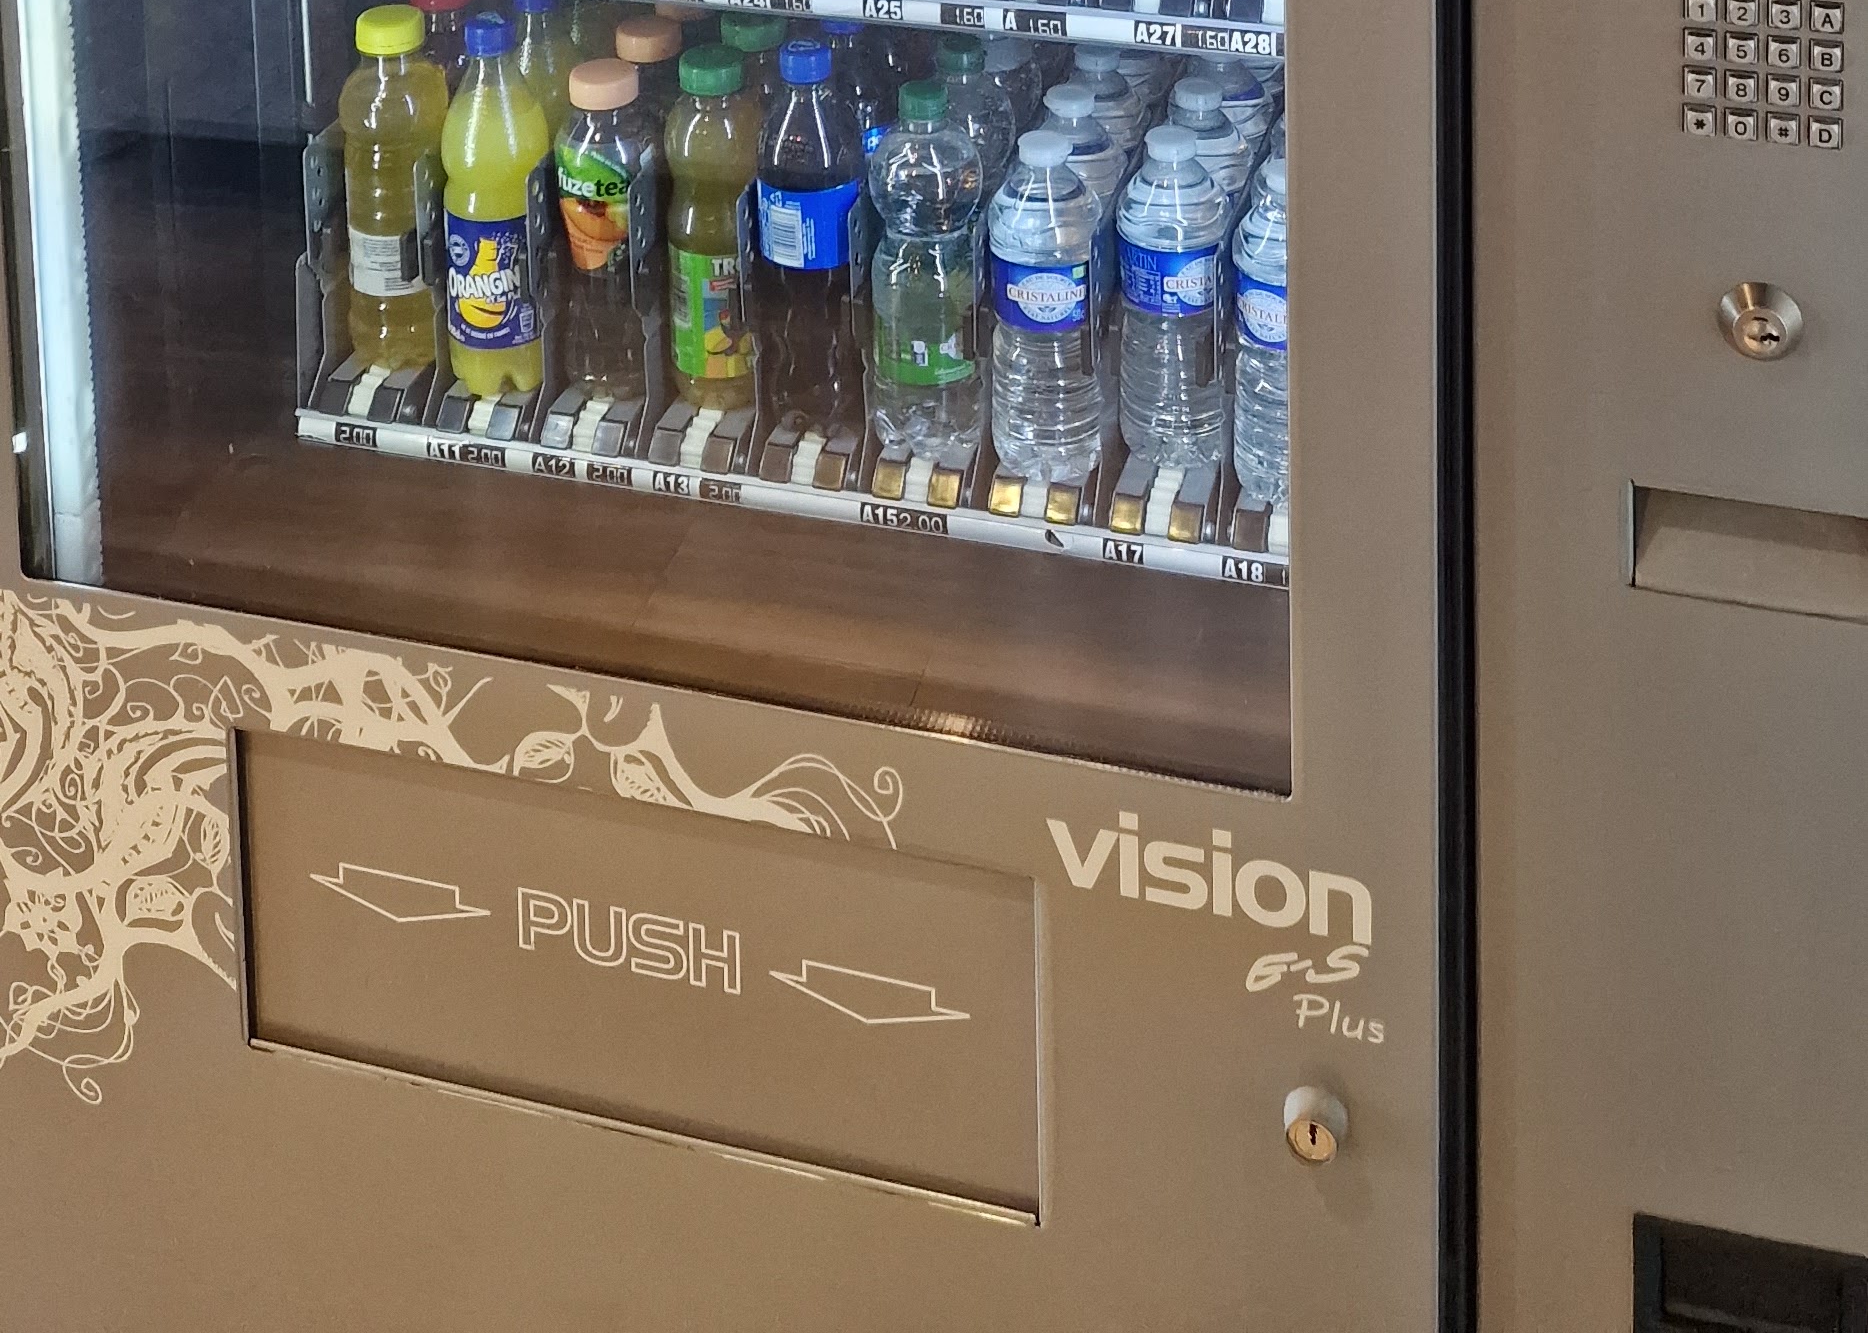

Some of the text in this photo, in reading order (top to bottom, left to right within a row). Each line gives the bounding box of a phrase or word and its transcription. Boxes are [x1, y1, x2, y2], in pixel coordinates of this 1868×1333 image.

[865, 0, 984, 25] A25 1.60
[1697, 3, 1835, 30] 1 2 3 A
[1029, 17, 1061, 36] 1.60
[1135, 23, 1228, 49] A27 1.60
[1230, 32, 1272, 54] A28
[1693, 41, 1834, 68] 4 5 6 B
[1694, 78, 1833, 106] 7 8 9 C
[1734, 120, 1748, 136] 0
[1818, 128, 1833, 144] D
[556, 165, 630, 198] fuzetea
[339, 426, 374, 447] 2.00
[429, 439, 502, 467] A11 2.00
[534, 455, 628, 485] A12 2.00
[654, 472, 741, 504] A13 2.00
[862, 504, 943, 534] A15 2.00
[1104, 540, 1143, 564] A17
[1224, 558, 1264, 583] A18
[1045, 810, 1372, 946] vision
[515, 885, 742, 995] PUSH
[1292, 993, 1385, 1044] Plus
